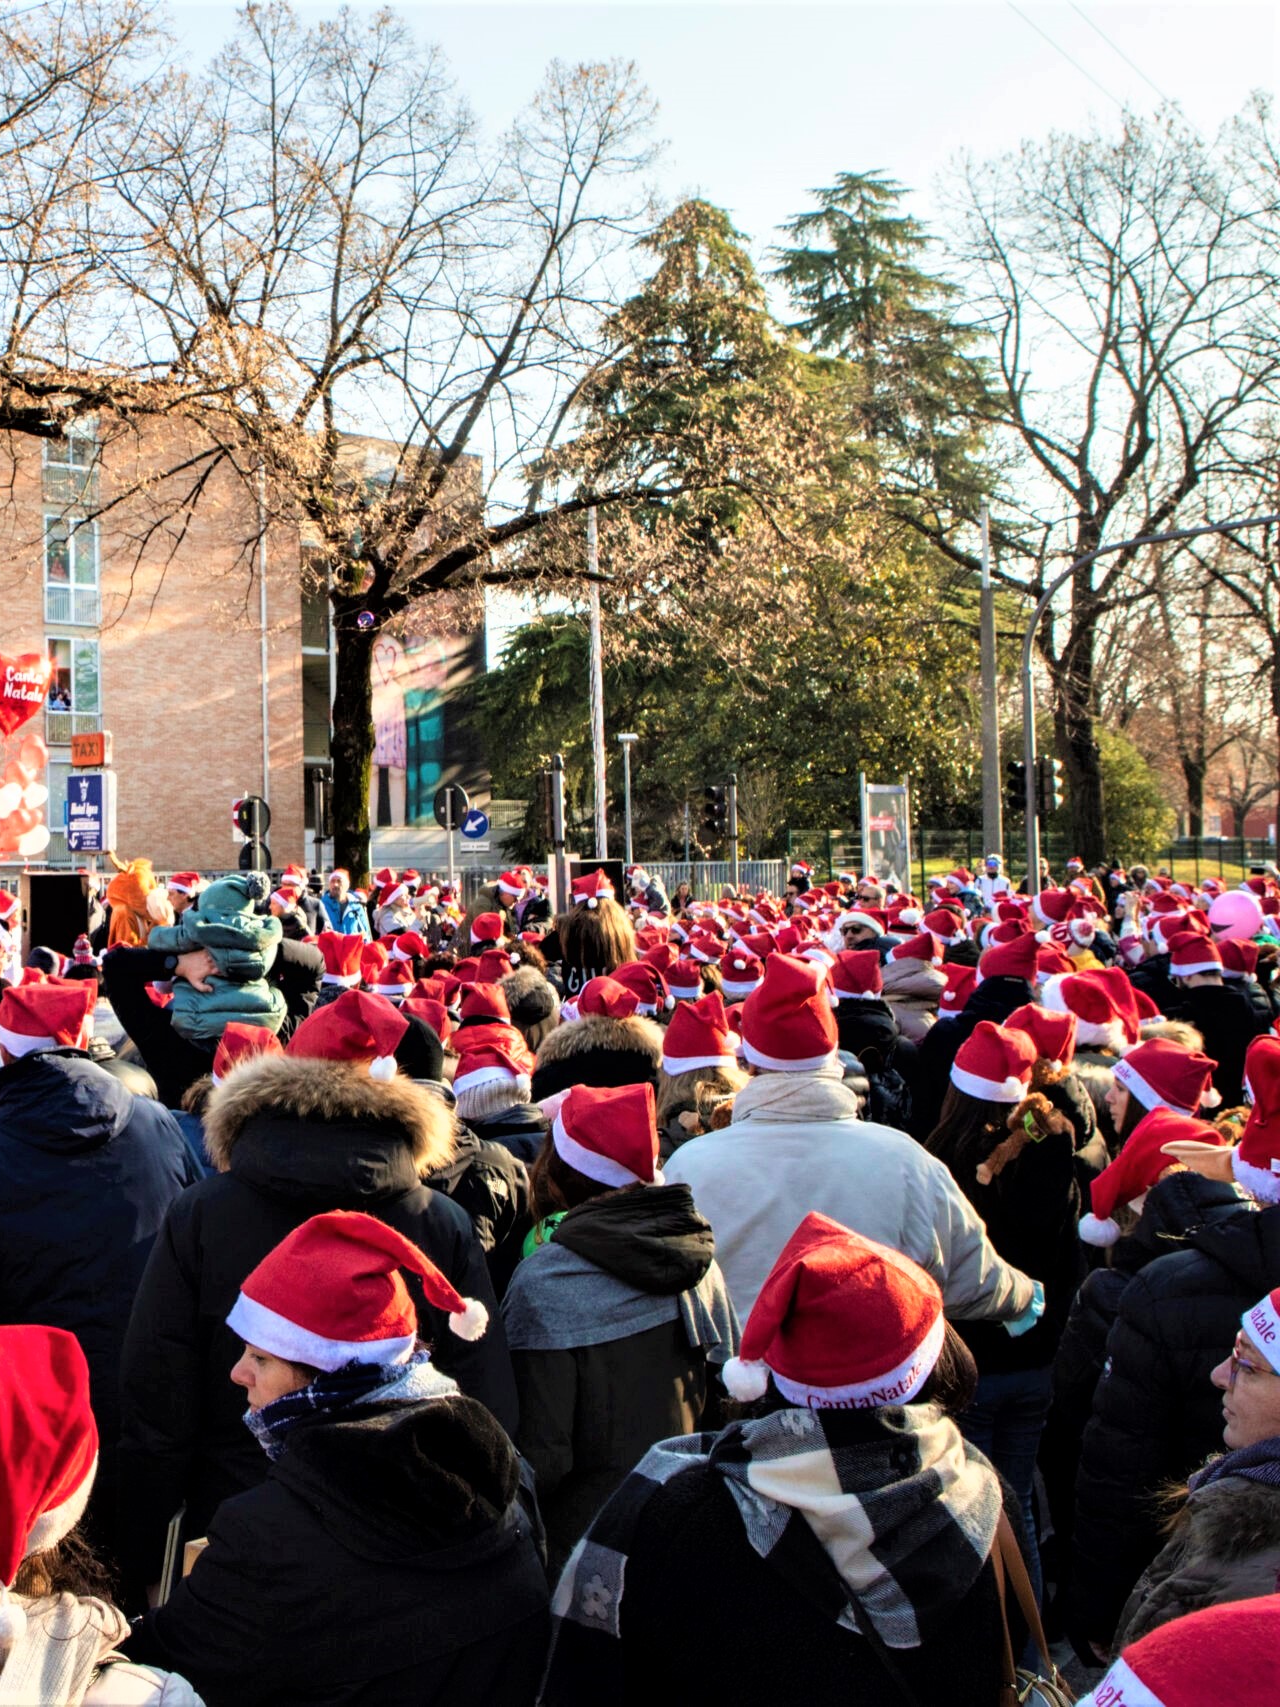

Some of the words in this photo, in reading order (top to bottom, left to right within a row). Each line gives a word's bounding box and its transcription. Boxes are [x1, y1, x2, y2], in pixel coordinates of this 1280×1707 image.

[5, 665, 44, 685] Canta
[3, 682, 44, 703] Natale
[73, 742, 99, 758] TAXI
[1249, 1302, 1276, 1344] atale
